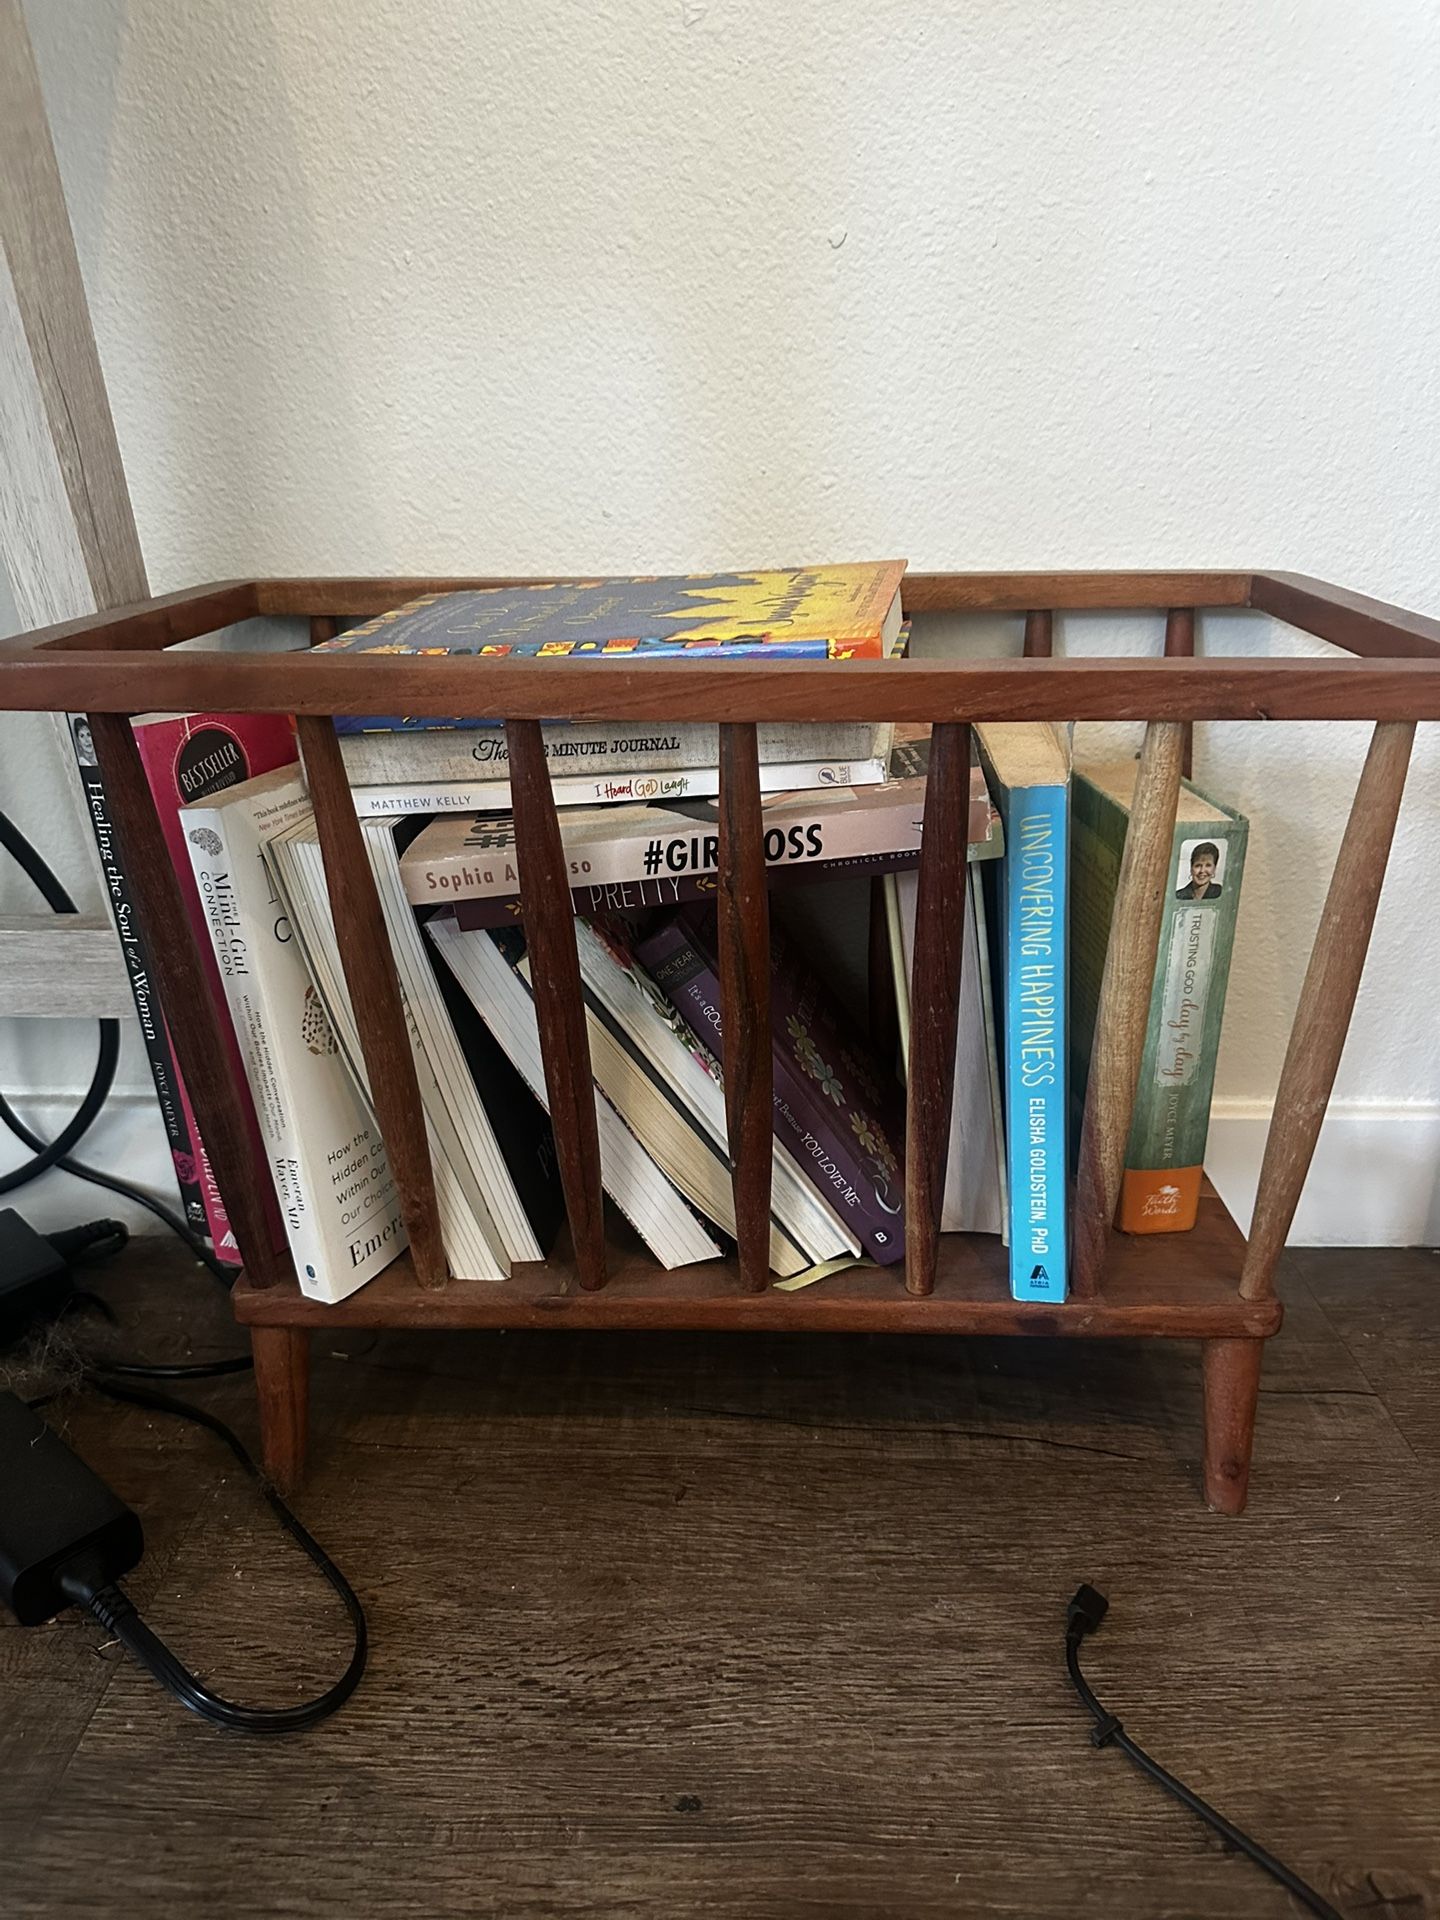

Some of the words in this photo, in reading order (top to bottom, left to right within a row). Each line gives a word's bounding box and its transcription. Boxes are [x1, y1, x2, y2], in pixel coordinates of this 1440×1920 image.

[180, 742, 240, 793] BESTSELLER
[472, 739, 509, 762] The
[552, 741, 607, 758] MINUTE
[610, 736, 681, 754] JOURNAL
[371, 797, 431, 810] MATTHEW
[436, 795, 471, 807] KELLY
[594, 784, 602, 798] I
[604, 780, 634, 799] Heard
[87, 782, 115, 860] Healing
[644, 823, 823, 876] #GIROSS
[823, 855, 884, 869] CHRONICLE
[889, 850, 922, 861] BOOK
[107, 866, 124, 896] the
[425, 865, 494, 892] Sophia
[1019, 814, 1054, 957] UNCOVERING
[115, 902, 138, 942] Soul
[200, 871, 234, 976] CONNECTION
[1187, 913, 1202, 968] TRUSTING
[656, 964, 674, 980] ONE
[671, 950, 695, 970] YEAR
[1183, 969, 1196, 995] GOD
[133, 970, 156, 1040] Woman
[1020, 964, 1055, 1087] HAPPINESS
[1168, 998, 1199, 1033] day
[1161, 1046, 1193, 1078] day
[153, 1061, 170, 1096] JOYCE
[162, 1099, 179, 1137] MEYER
[1166, 1093, 1179, 1123] JOYCE
[1029, 1097, 1046, 1145] ELISHA
[327, 1143, 351, 1165] How
[353, 1129, 370, 1147] the
[1162, 1126, 1176, 1160] MEYER
[287, 1158, 305, 1212] Emeran
[331, 1154, 369, 1186] Hidden
[336, 1176, 370, 1205] Within
[370, 1161, 387, 1181] Our
[800, 1132, 823, 1158] YOU
[817, 1157, 847, 1189] LOVE
[841, 1185, 861, 1208] ME
[1028, 1149, 1048, 1224] GOLDSTEIN,
[286, 1204, 301, 1230] MD
[340, 1205, 361, 1226] Our
[363, 1178, 395, 1209] Choice
[348, 1214, 404, 1269] Emer
